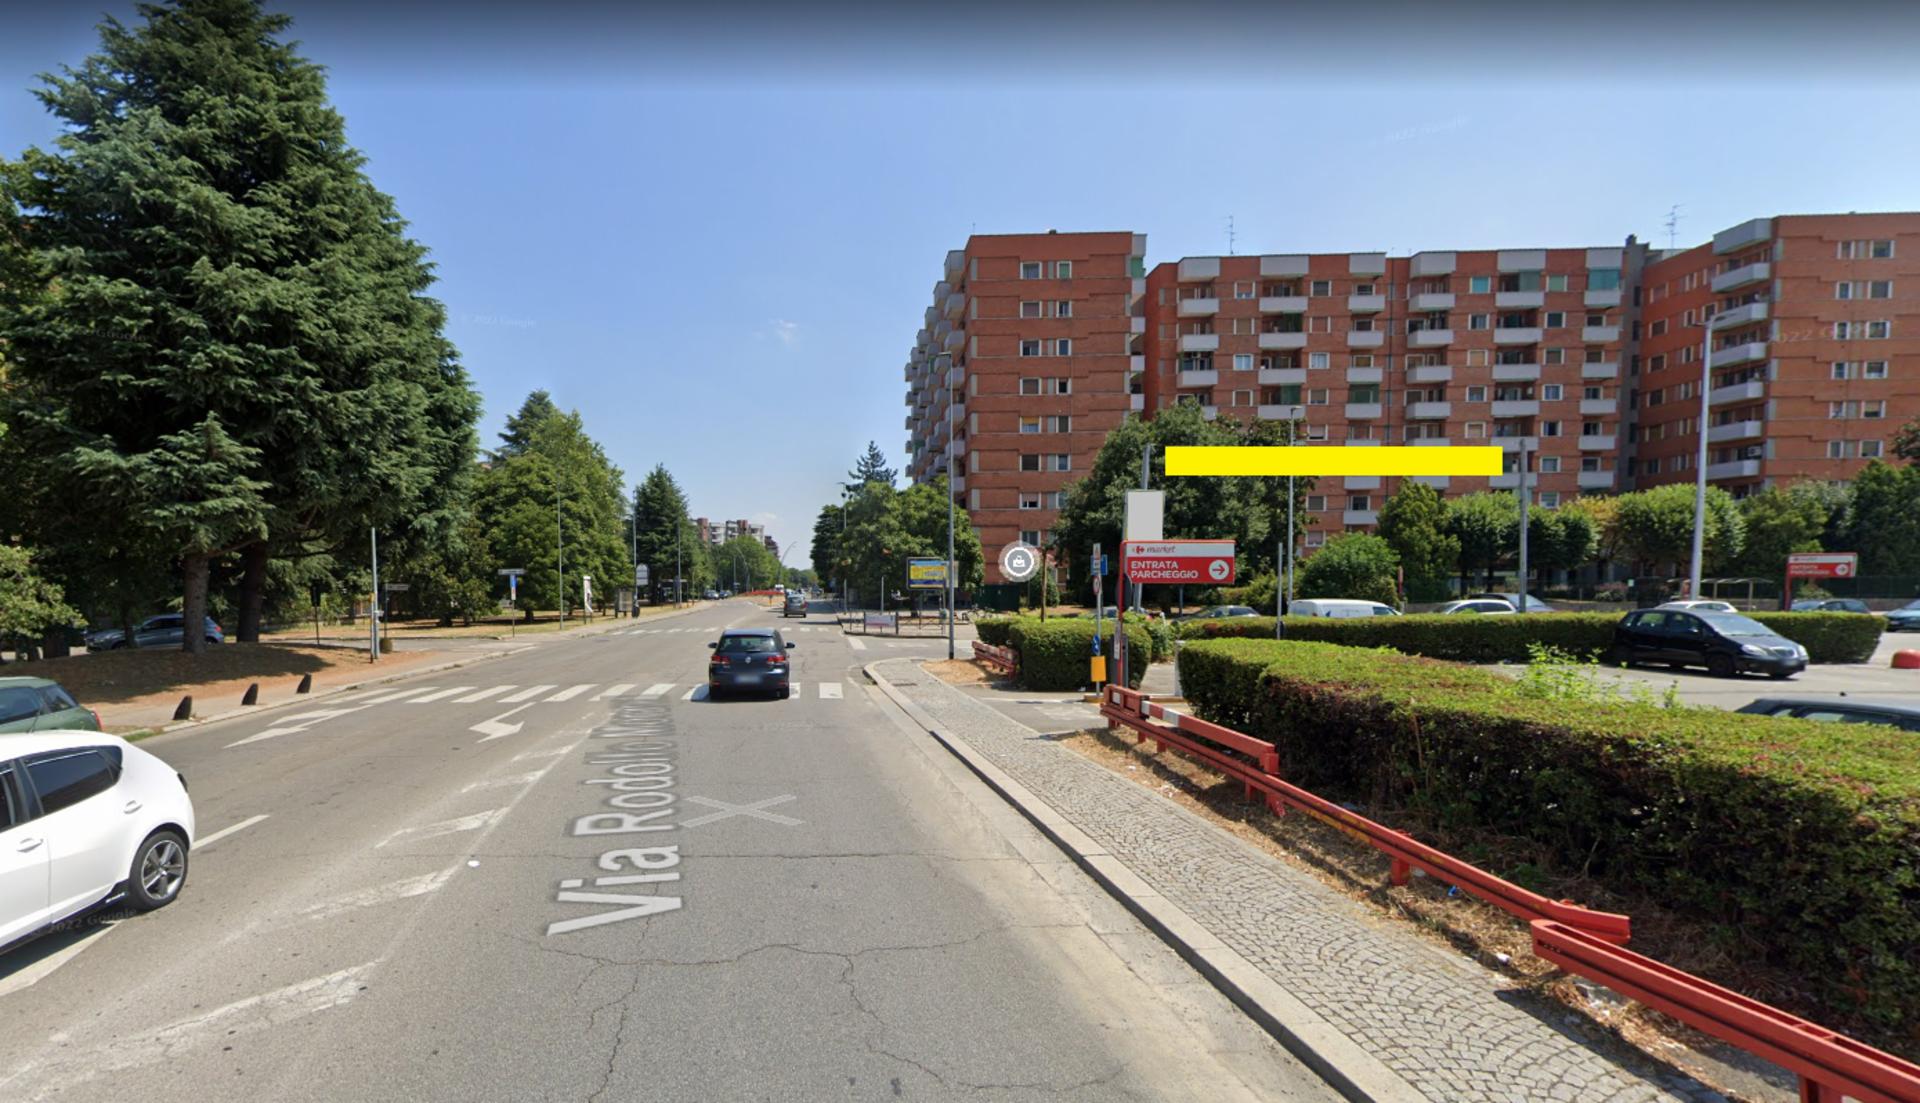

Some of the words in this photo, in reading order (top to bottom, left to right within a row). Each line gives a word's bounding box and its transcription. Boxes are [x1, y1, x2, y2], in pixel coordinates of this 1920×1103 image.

[1146, 545, 1176, 554] market
[1131, 560, 1178, 569] ENTRATA
[1131, 570, 1198, 579] PARCHEGGIO
